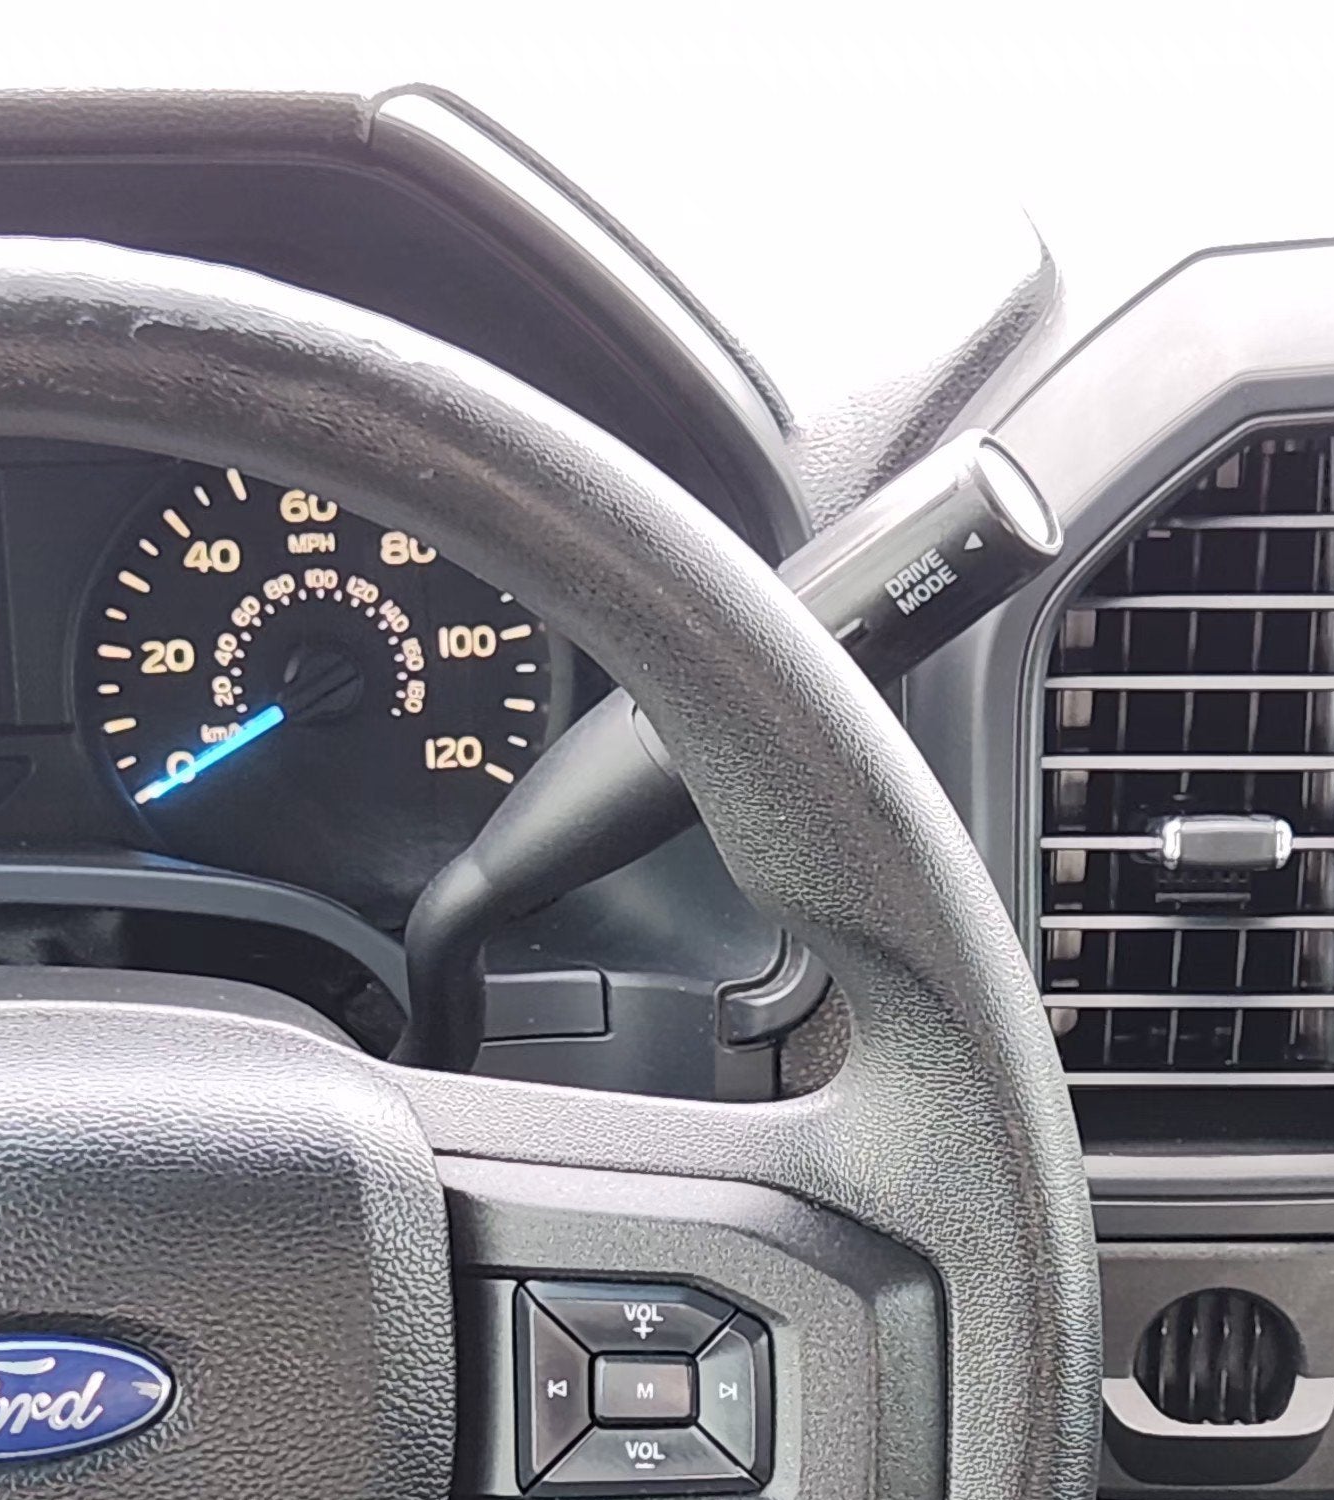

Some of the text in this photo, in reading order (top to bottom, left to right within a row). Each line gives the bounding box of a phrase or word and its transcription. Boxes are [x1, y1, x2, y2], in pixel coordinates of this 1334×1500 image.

[183, 539, 241, 573] 40
[287, 532, 336, 554] MPH
[304, 567, 339, 590] 100
[345, 574, 379, 604] 120
[884, 548, 945, 600] DRIVE
[895, 564, 958, 616] MODE
[140, 638, 195, 674] 20
[439, 624, 497, 659] 100
[425, 735, 482, 770] 120
[623, 1303, 664, 1323] VOL
[636, 1382, 654, 1399] M
[624, 1441, 666, 1461] VOL
